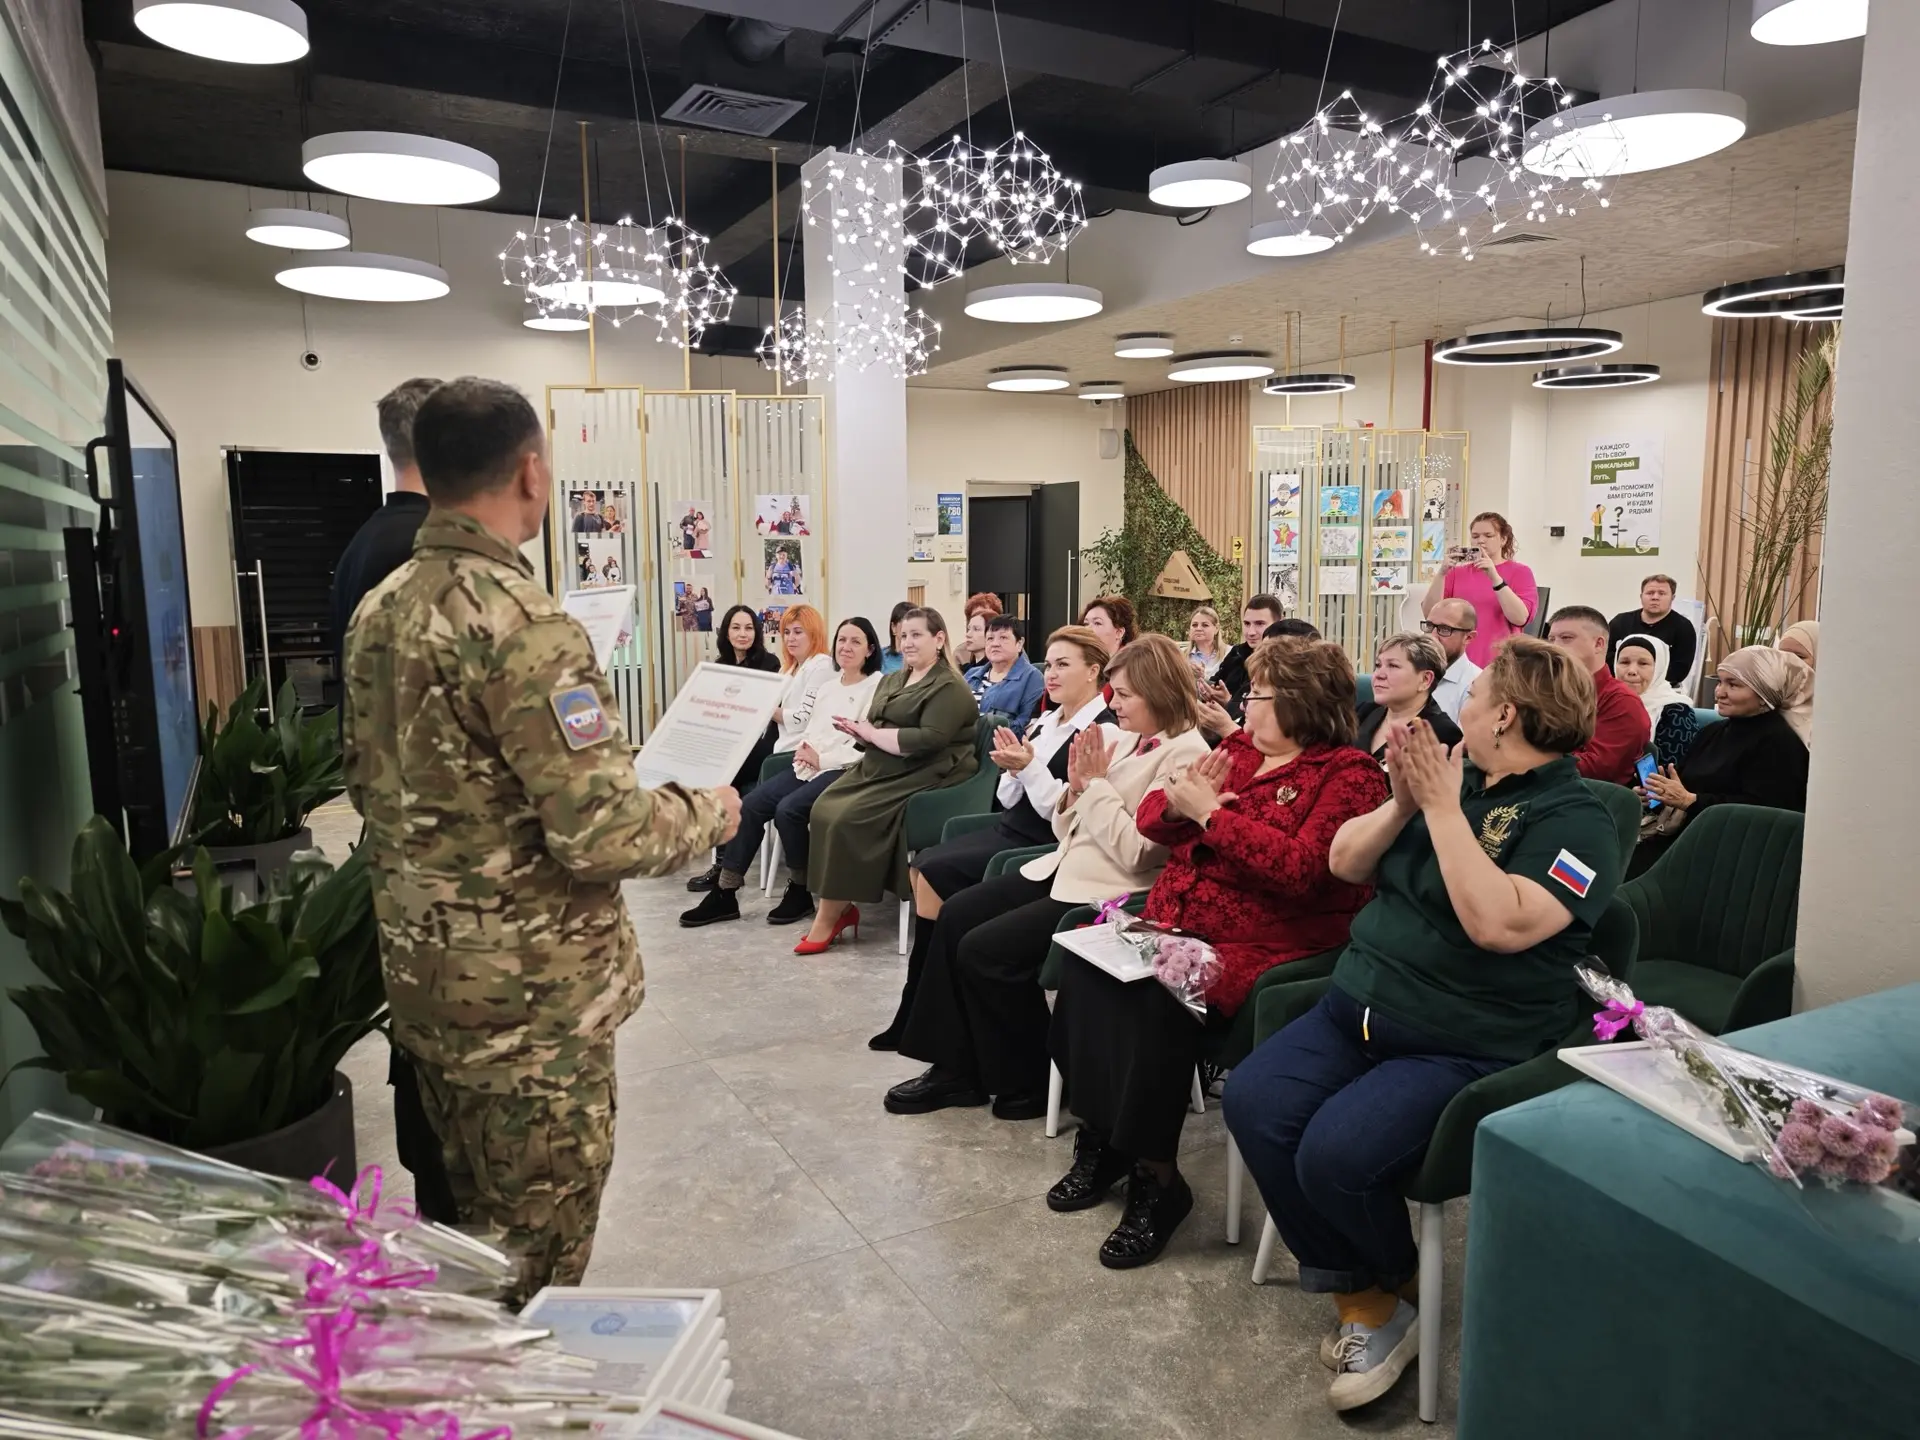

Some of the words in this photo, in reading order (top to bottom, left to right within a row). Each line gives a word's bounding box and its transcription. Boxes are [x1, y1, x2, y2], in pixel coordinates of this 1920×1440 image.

[1600, 443, 1630, 451] КАЖДОГО
[1610, 450, 1627, 458] СВОЙ
[1594, 460, 1635, 470] УНИКАЛЬНЫЙ
[1633, 490, 1654, 498] НАЙТИ
[1628, 507, 1653, 515] РЯДОМ!
